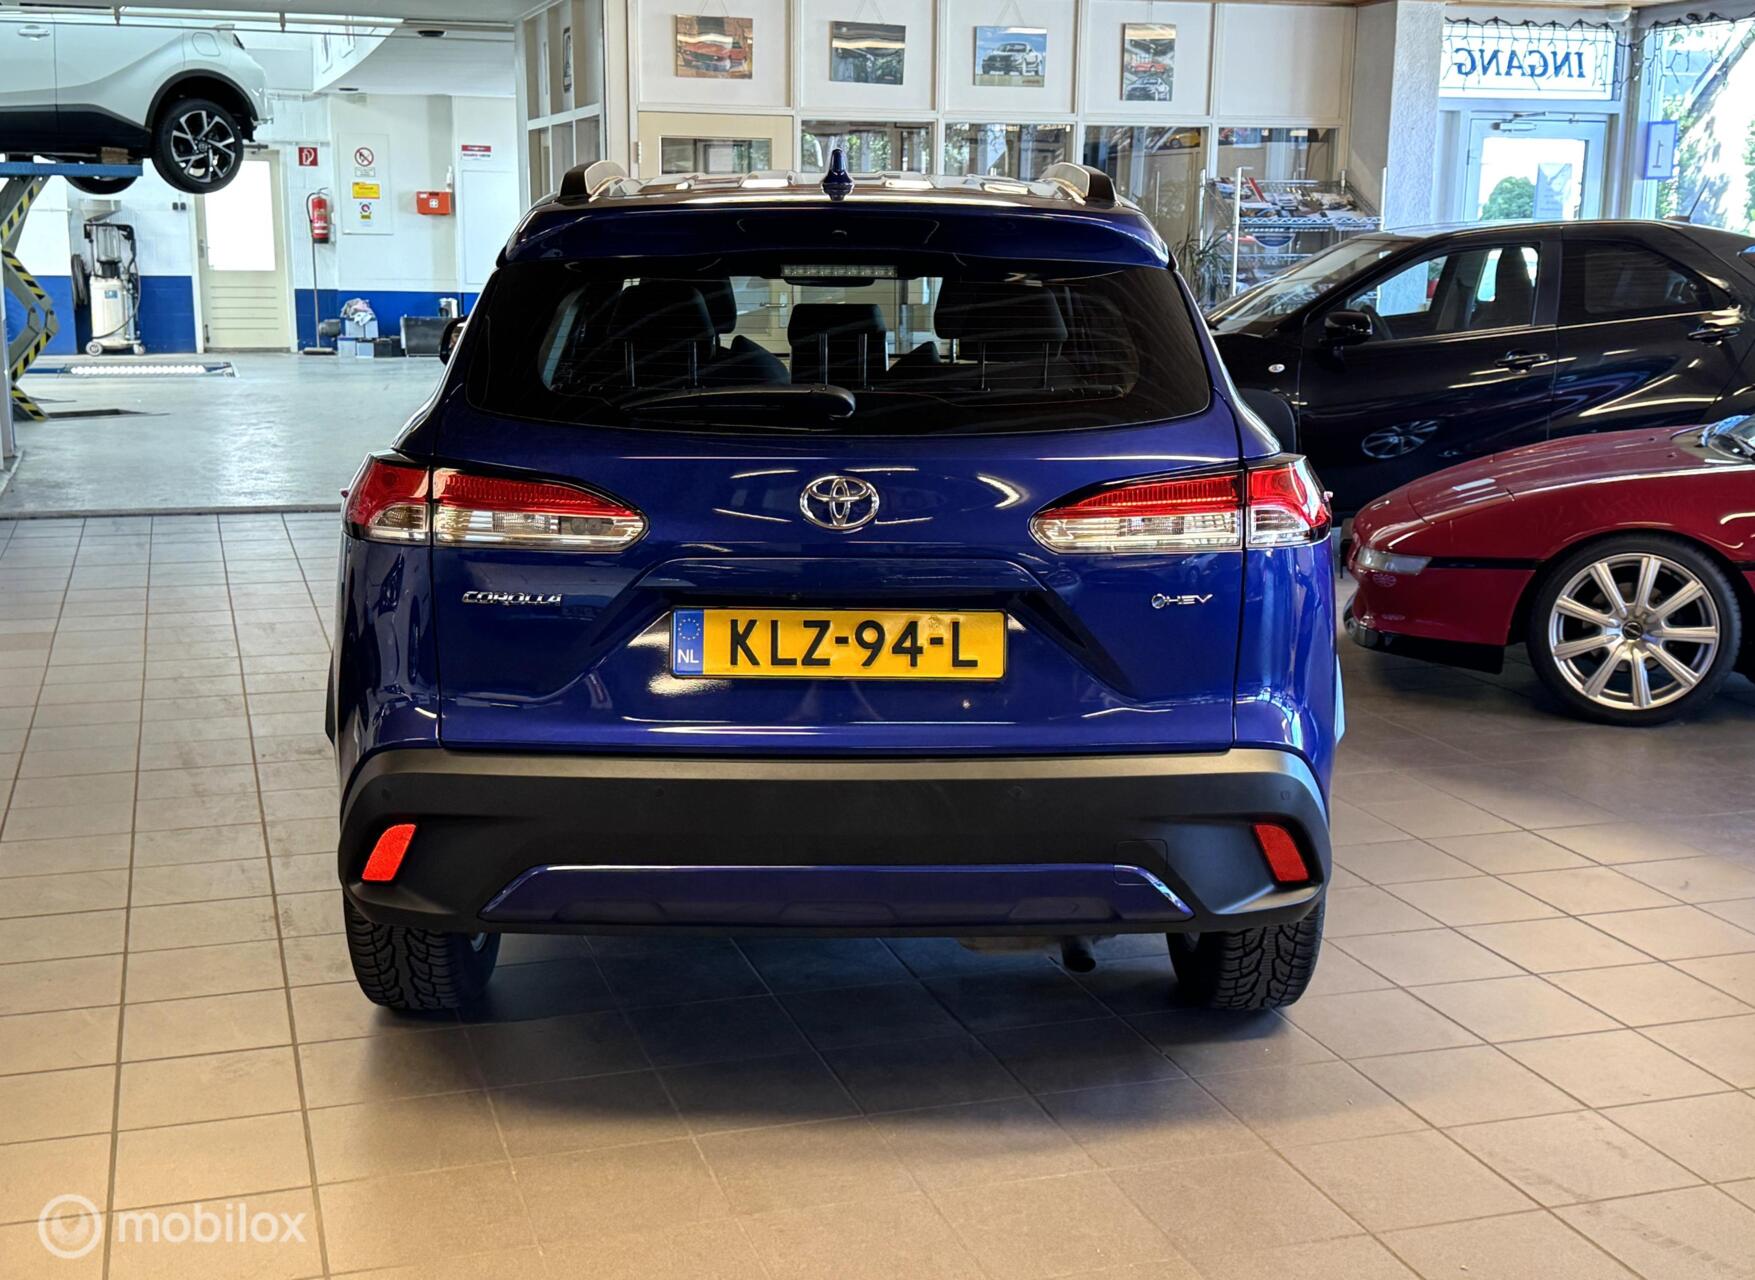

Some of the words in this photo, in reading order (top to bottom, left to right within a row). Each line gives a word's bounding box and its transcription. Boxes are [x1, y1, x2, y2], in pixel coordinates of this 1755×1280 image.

[462, 591, 562, 606] COROLLA
[729, 618, 979, 668] KLZ-94-L
[677, 648, 700, 664] NL
